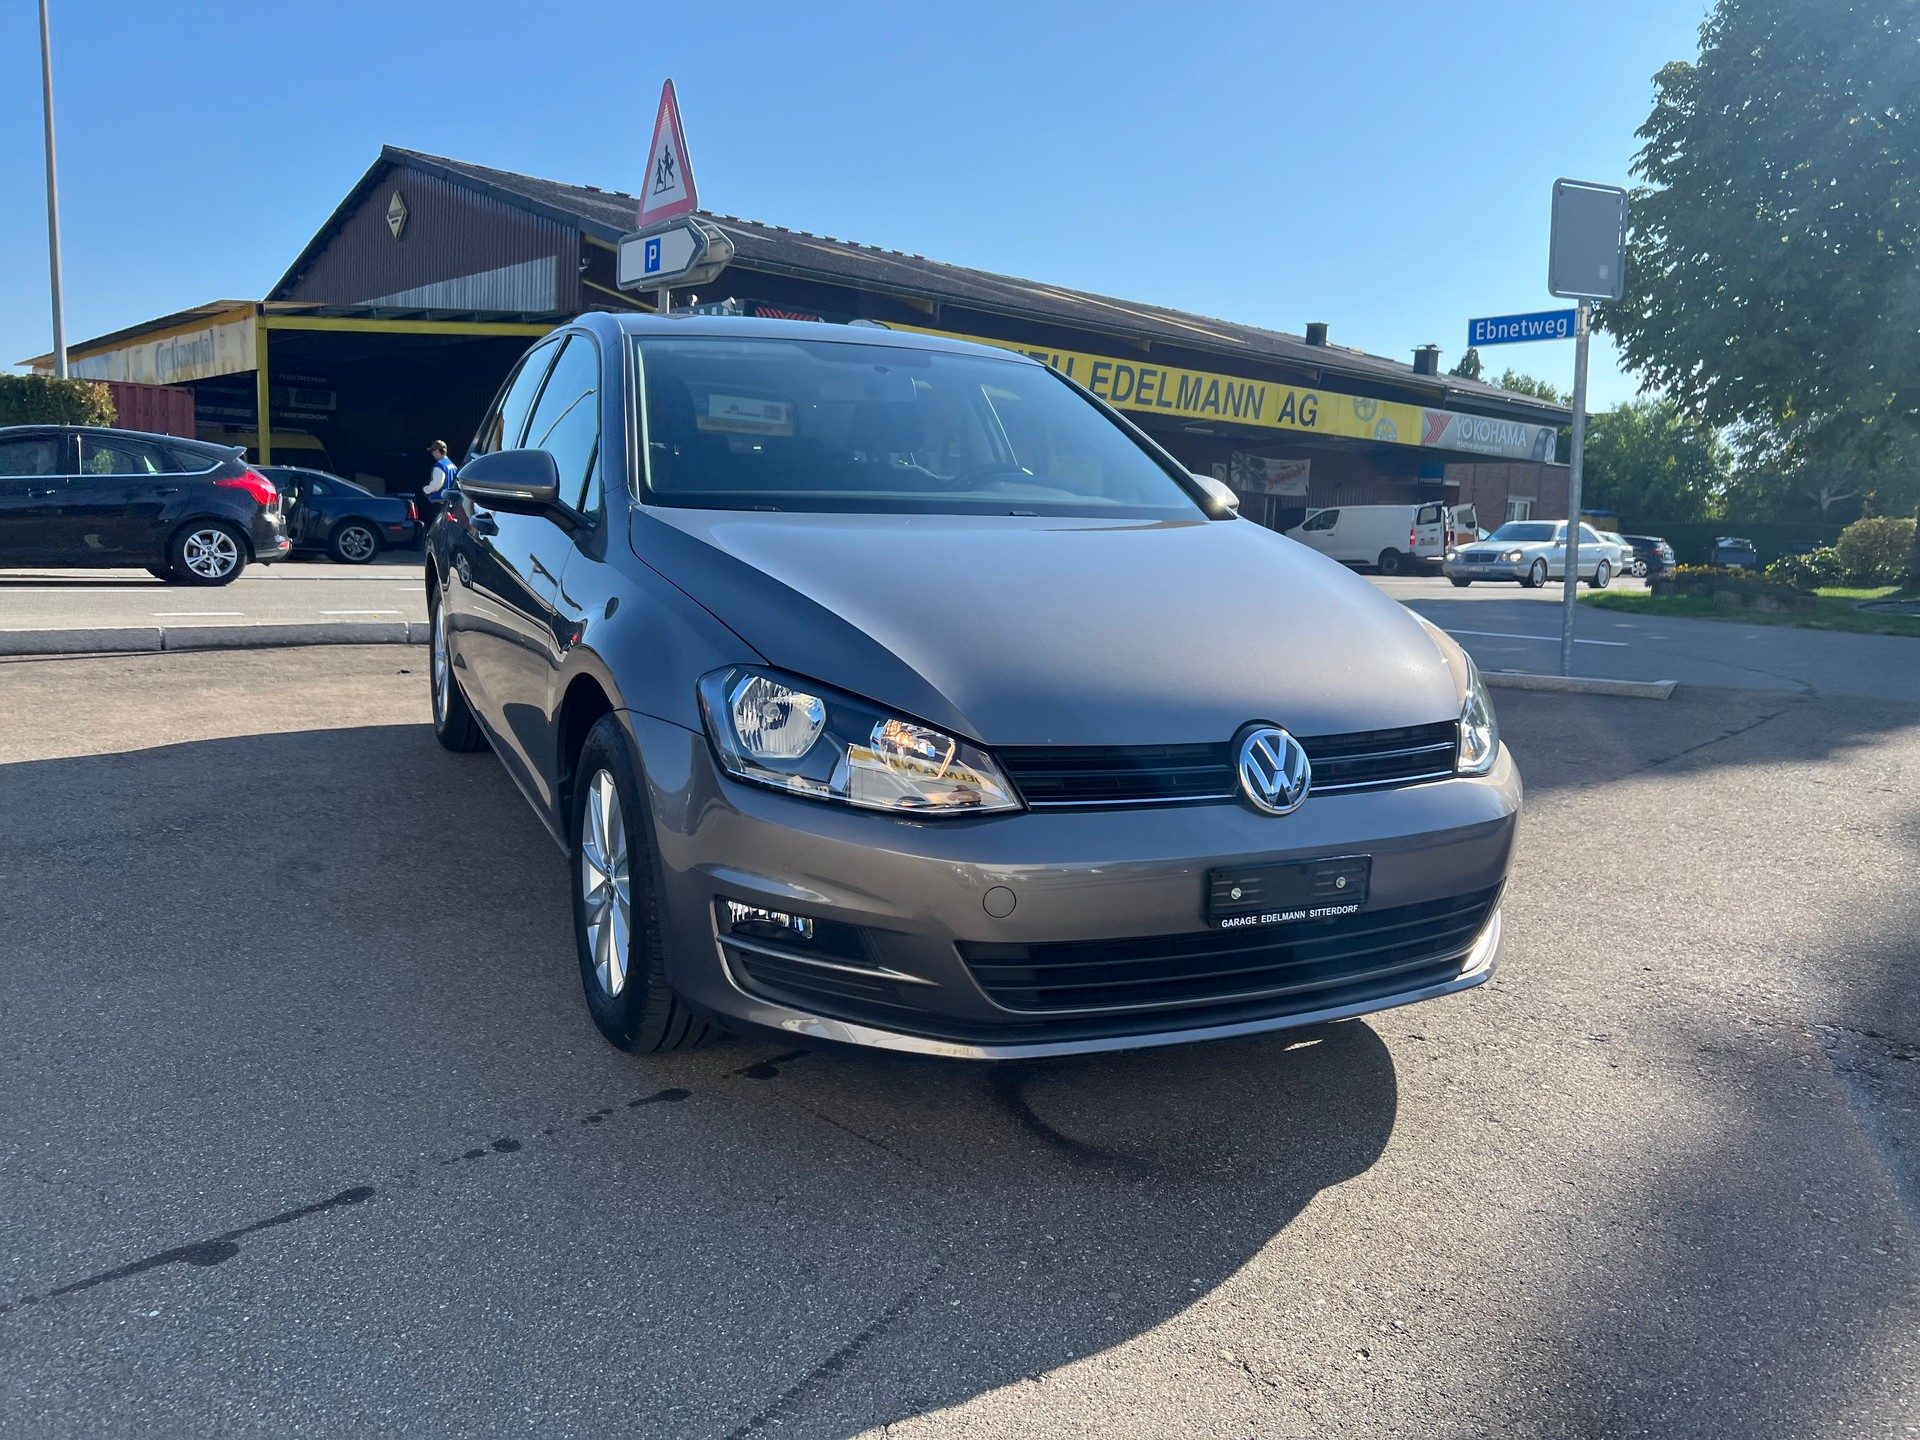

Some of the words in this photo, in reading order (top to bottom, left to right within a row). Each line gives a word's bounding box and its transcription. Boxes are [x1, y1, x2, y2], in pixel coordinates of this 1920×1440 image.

[648, 244, 658, 269] P
[1475, 318, 1568, 341] Ebnetweg
[1089, 360, 1265, 420] EDELMANN
[1277, 391, 1319, 428] AG
[1456, 417, 1527, 448] YOKOHAMA
[1221, 916, 1257, 928] GARAGE
[1261, 910, 1306, 923] EDELMANN
[1309, 904, 1359, 918] SITTERDORF
